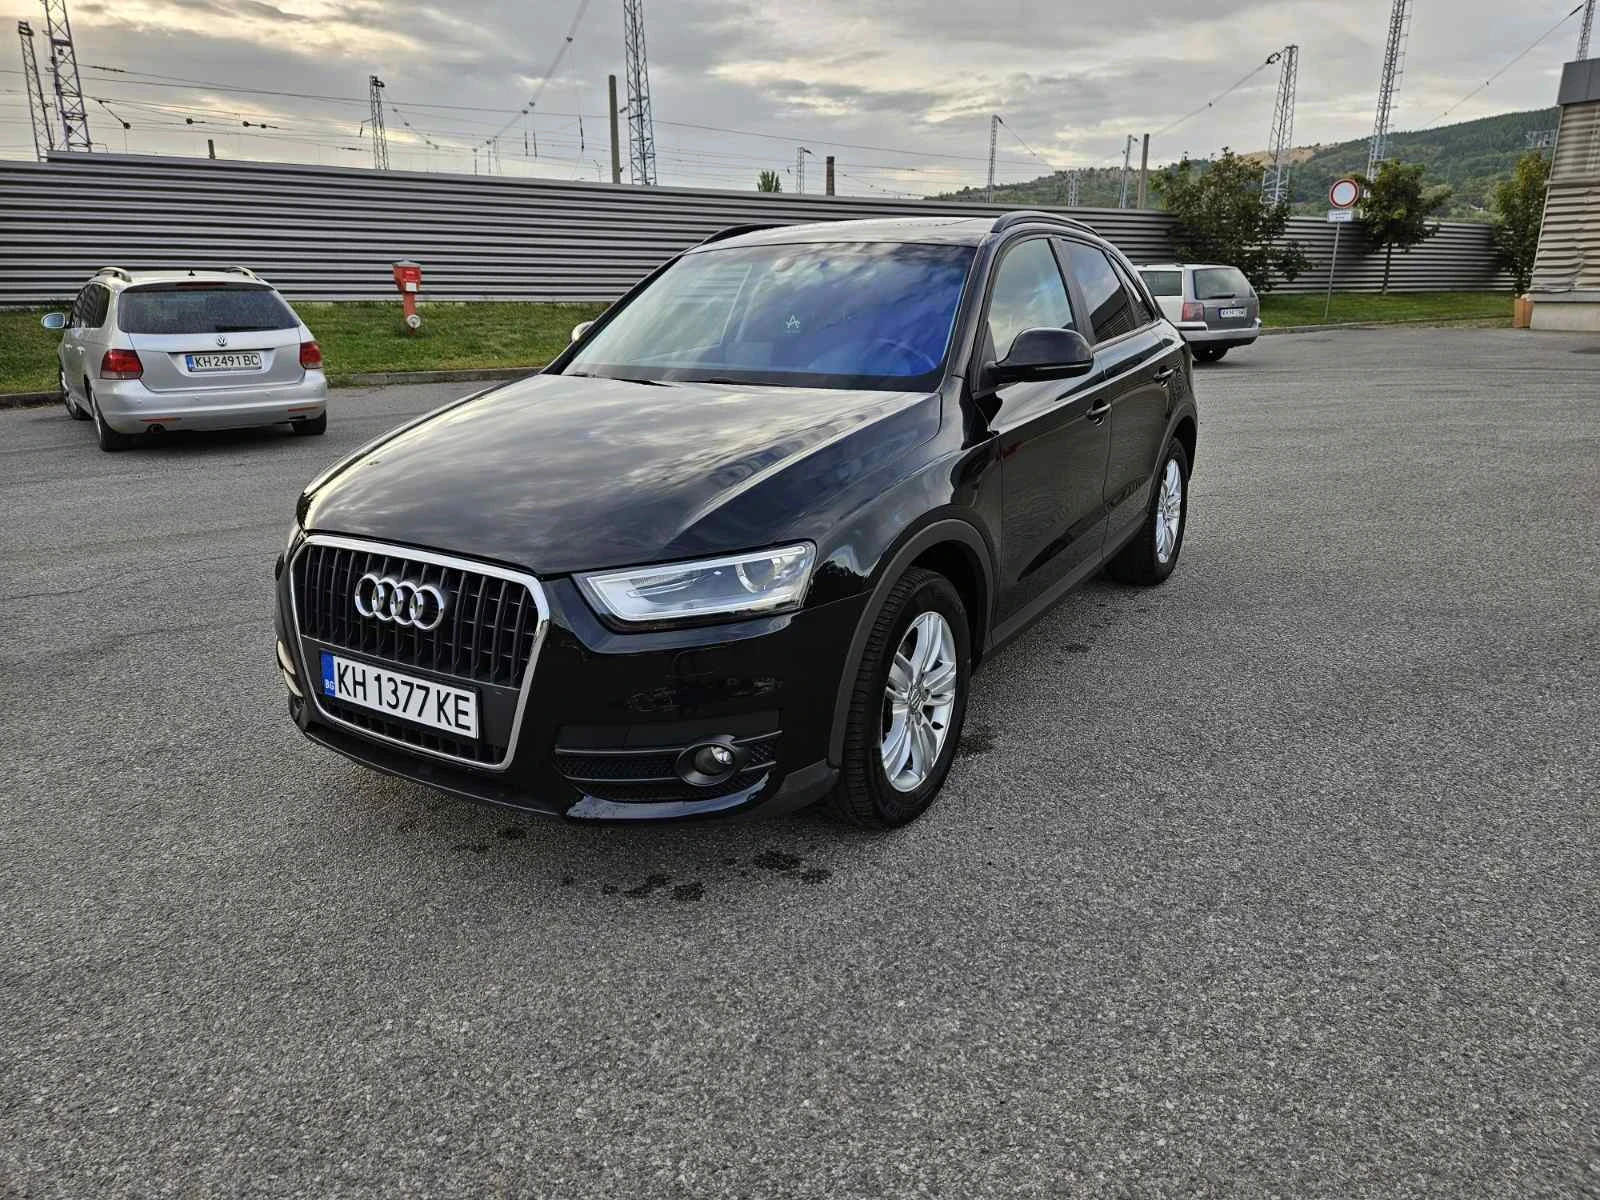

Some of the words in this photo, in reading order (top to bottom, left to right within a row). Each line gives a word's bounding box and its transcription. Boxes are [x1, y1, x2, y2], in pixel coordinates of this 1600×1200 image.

[194, 356, 212, 367] KH
[213, 355, 241, 367] 2491
[243, 354, 259, 366] BC
[324, 679, 335, 691] BG
[337, 662, 367, 701] KH
[374, 673, 430, 718] 1377
[437, 689, 471, 731] KE
